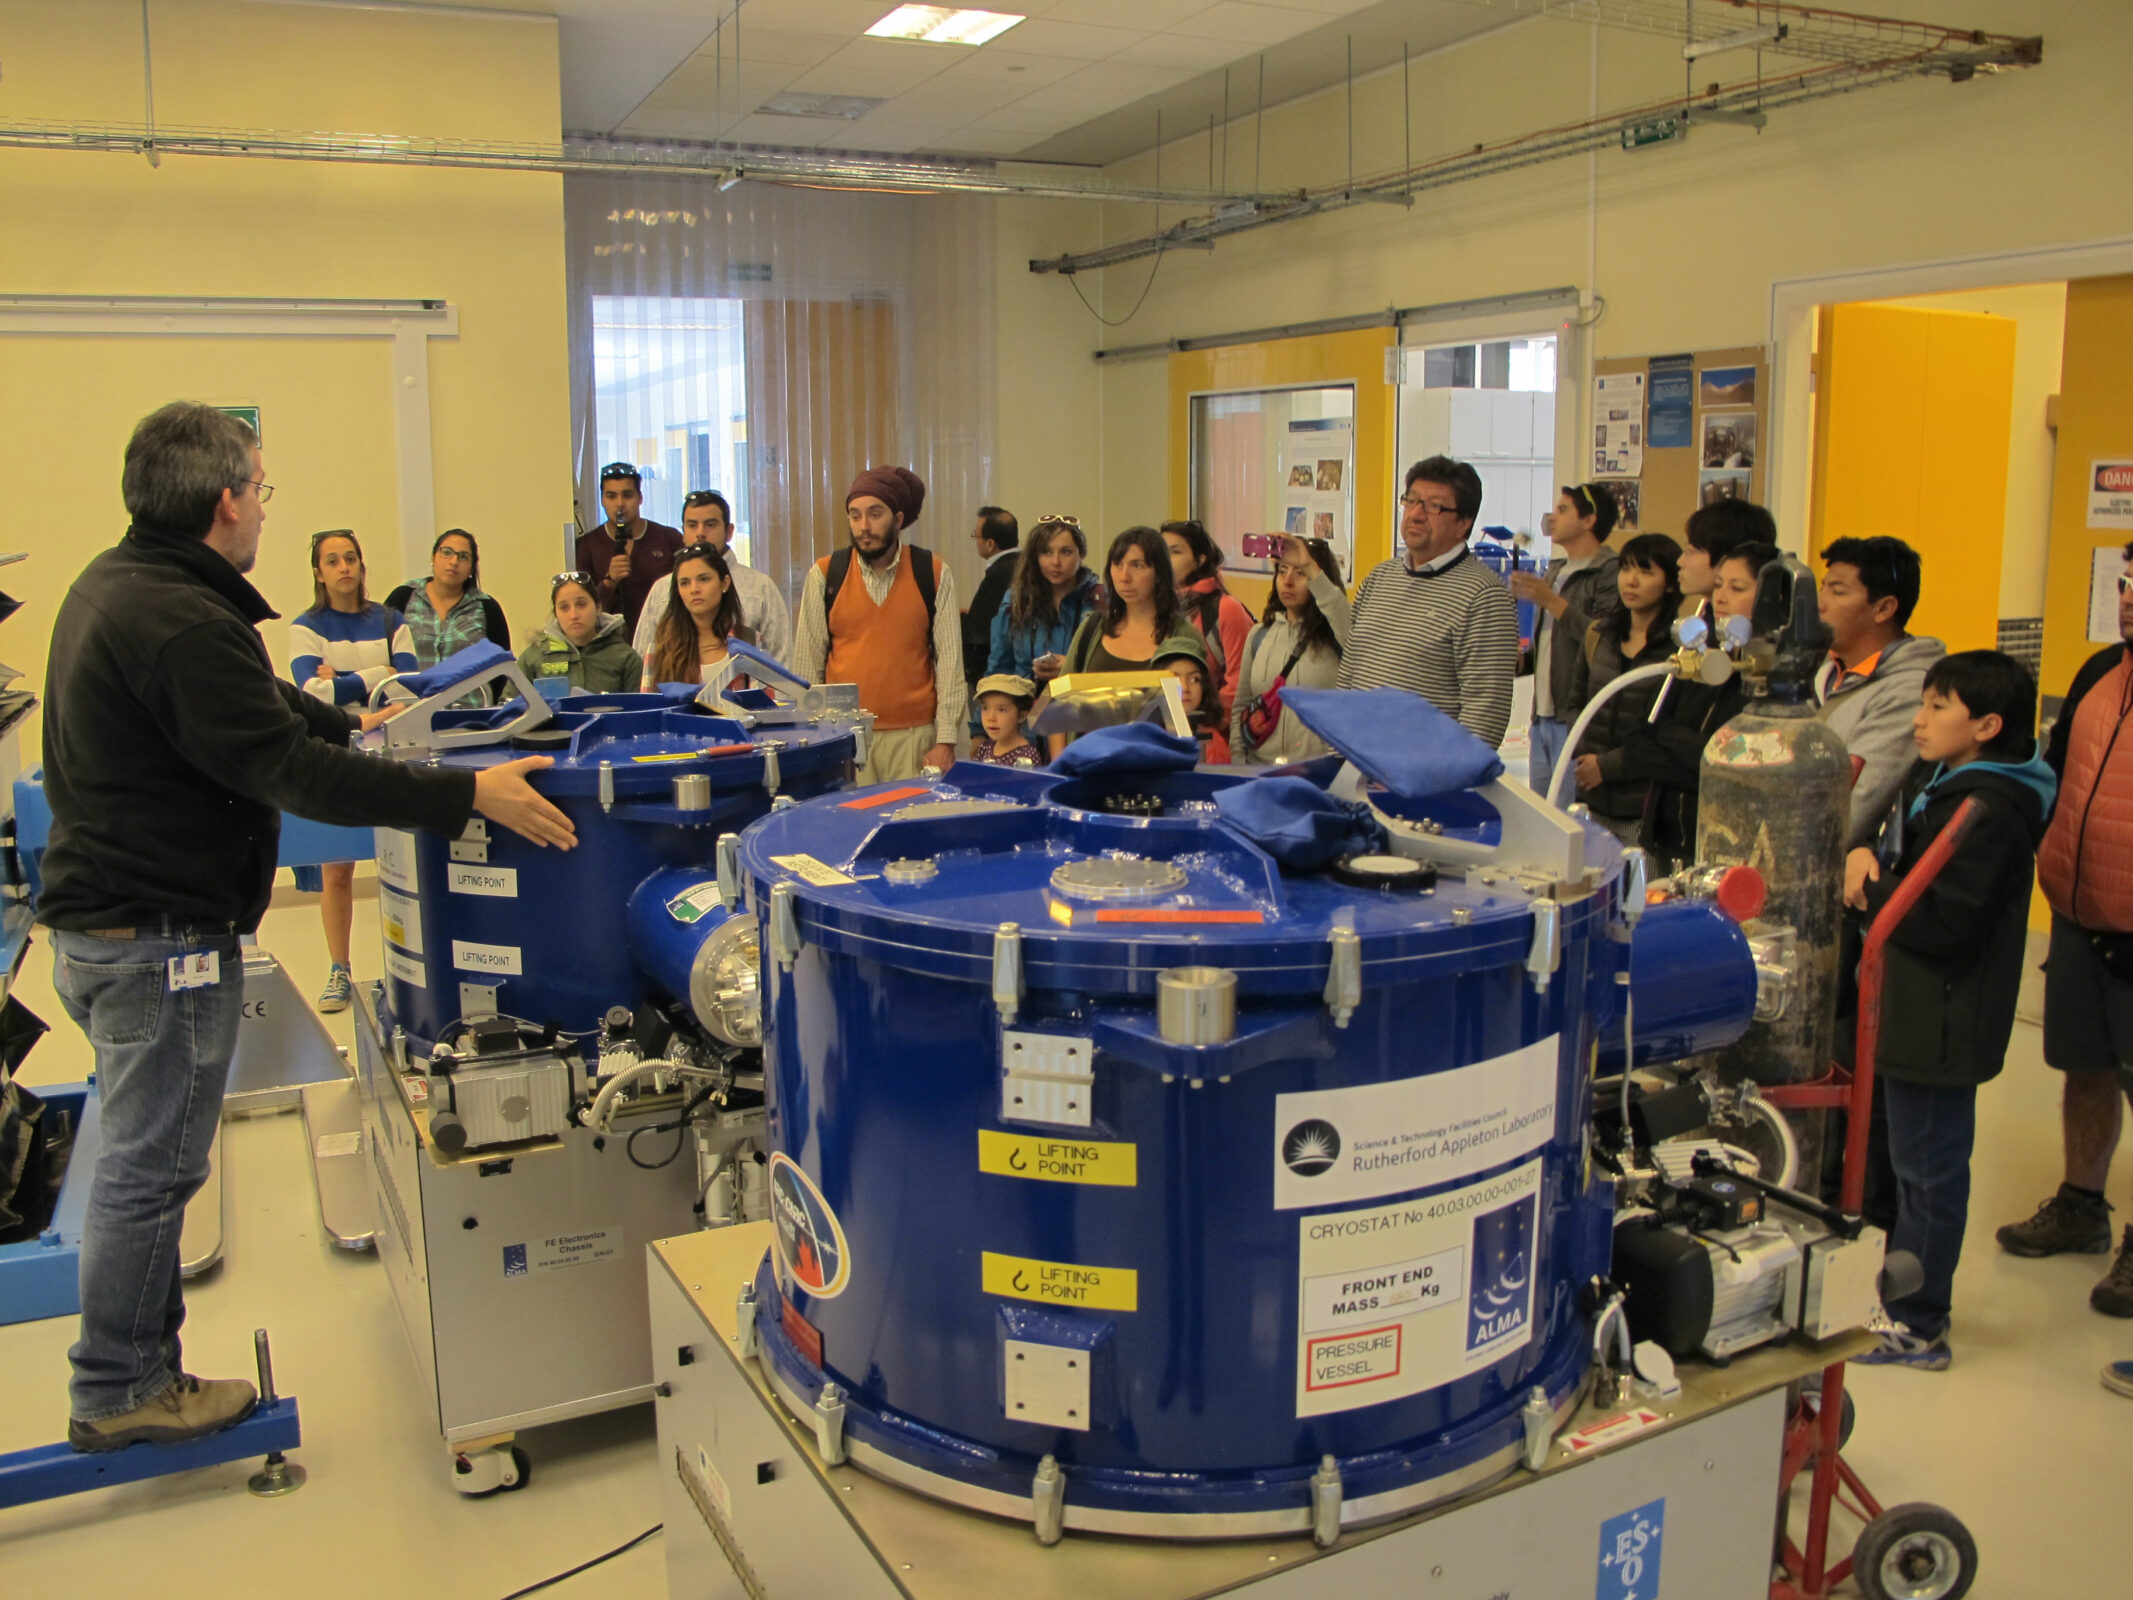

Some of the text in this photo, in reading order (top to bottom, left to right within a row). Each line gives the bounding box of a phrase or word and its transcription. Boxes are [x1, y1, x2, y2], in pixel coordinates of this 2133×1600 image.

[457, 875, 506, 889] LIFTING POINT
[462, 952, 510, 967] LIFTING POINT
[1353, 1102, 1554, 1172] Rutherford Appleton Laboratory
[1354, 1106, 1508, 1151] Science & Technology Facilities Council
[1038, 1143, 1099, 1160] LIFTING
[1038, 1160, 1086, 1177] POINT
[1309, 1212, 1400, 1240] CRYOSTAT
[1404, 1210, 1423, 1226] No
[545, 1231, 606, 1248] FE Electronics
[559, 1242, 593, 1254] Chassis
[1040, 1266, 1100, 1285] LIFTING
[1341, 1265, 1434, 1296] FRONT END
[1040, 1283, 1088, 1301] POINT
[1332, 1296, 1380, 1316] MASS
[1420, 1283, 1441, 1298] Kg
[1474, 1307, 1523, 1345] ALMA
[1316, 1334, 1394, 1360] PRESSURE
[1316, 1360, 1373, 1380] VESSEL
